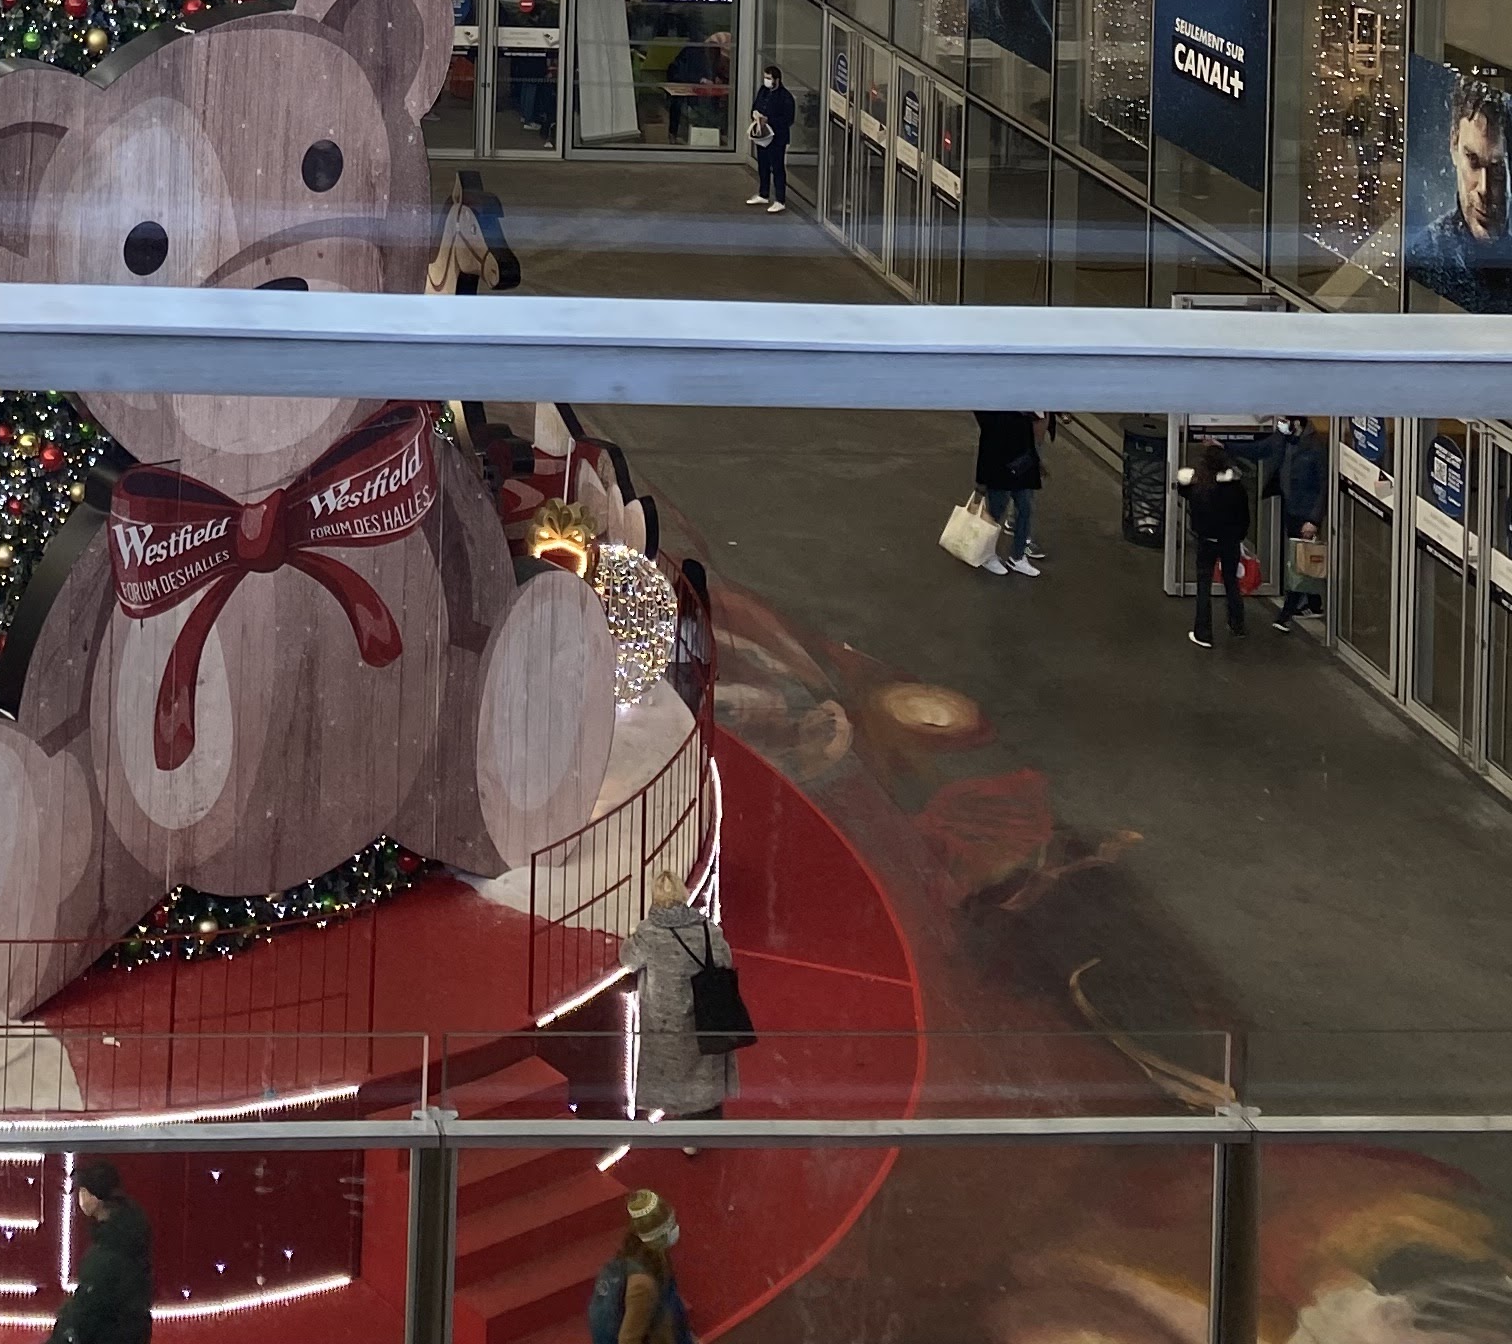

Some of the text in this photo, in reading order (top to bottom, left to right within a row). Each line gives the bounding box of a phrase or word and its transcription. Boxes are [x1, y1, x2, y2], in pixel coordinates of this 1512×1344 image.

[1174, 16, 1245, 64] SEULEMENT SUR
[1174, 42, 1245, 100] CANAL+
[307, 434, 424, 520] Westfield
[310, 484, 430, 541] FORUM DES HALLES
[111, 516, 232, 570] Westfield
[120, 549, 231, 603] FORUM DES HALLES
